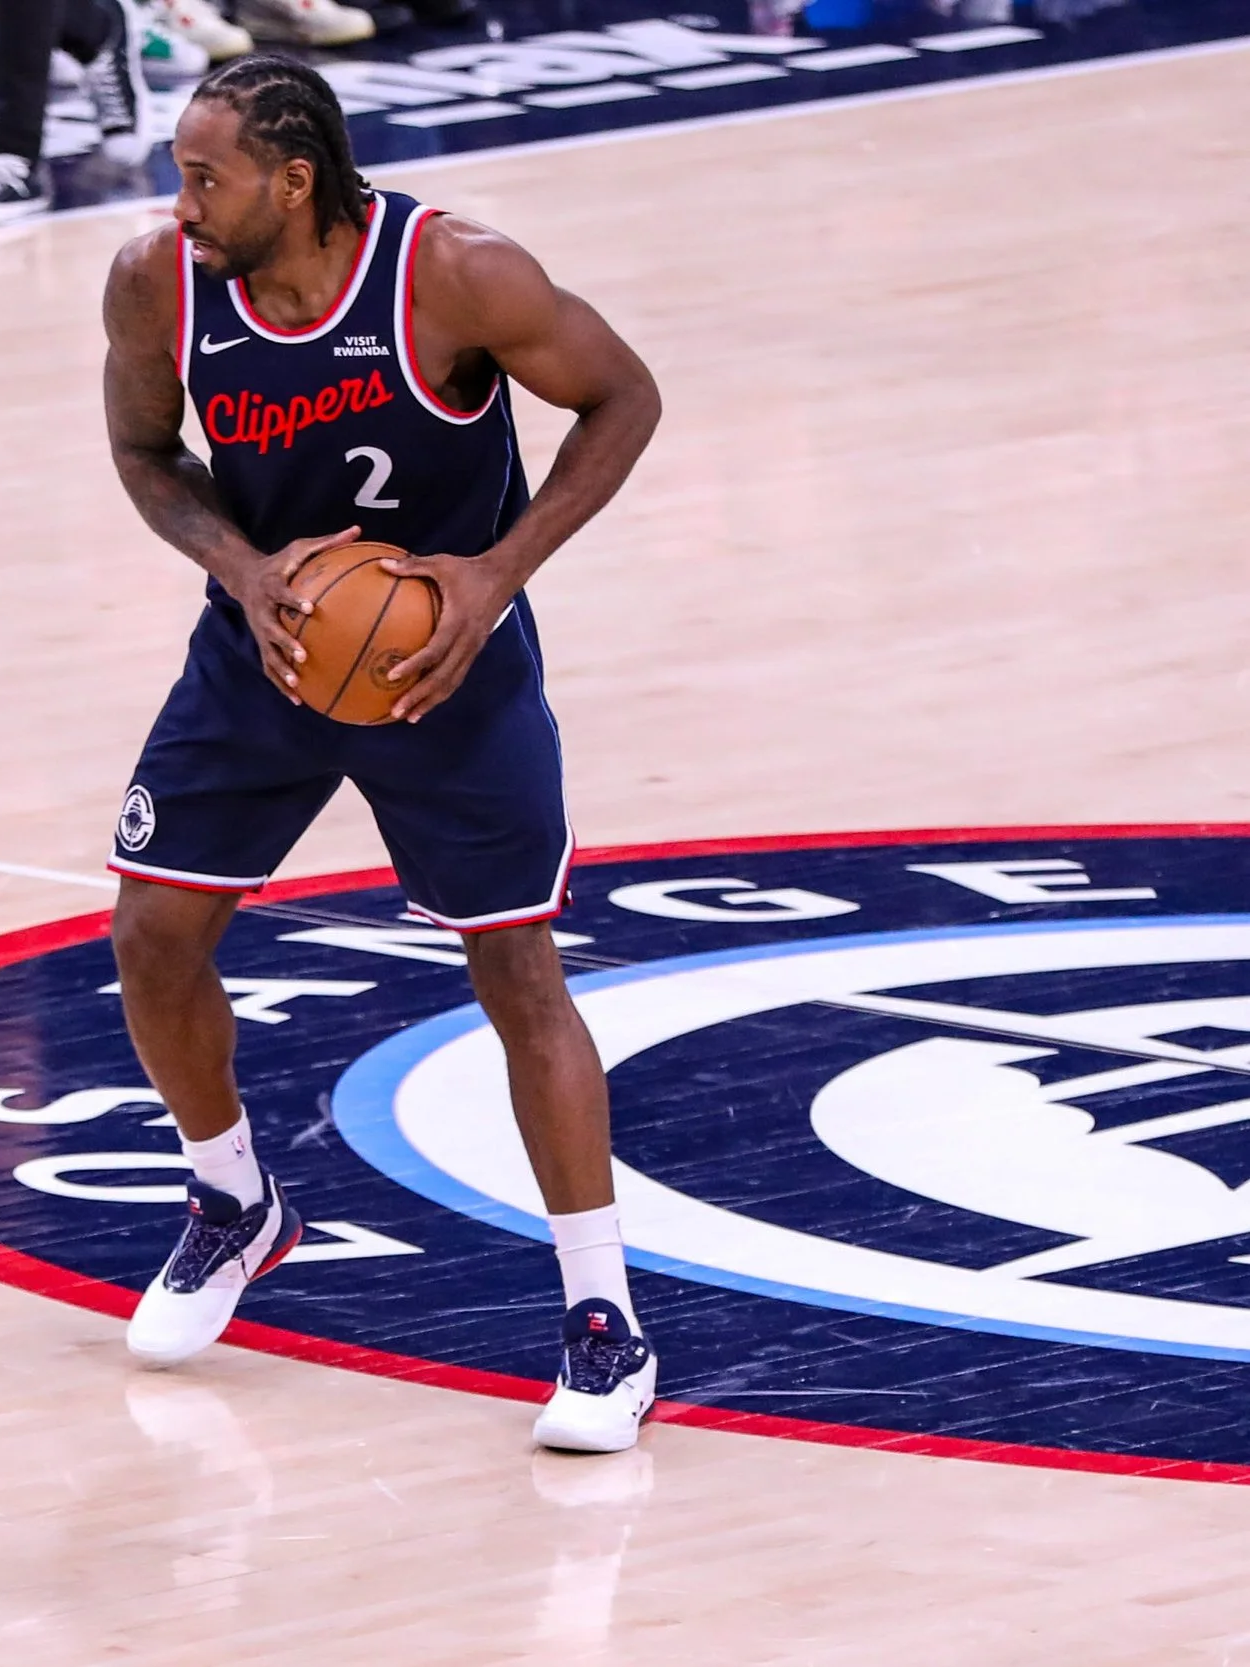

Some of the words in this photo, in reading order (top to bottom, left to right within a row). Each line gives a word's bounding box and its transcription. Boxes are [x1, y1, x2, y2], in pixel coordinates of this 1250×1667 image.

[334, 346, 390, 356] RWANDA
[345, 336, 377, 346] VISIT
[206, 369, 394, 454] Clippers
[345, 446, 400, 508] 2
